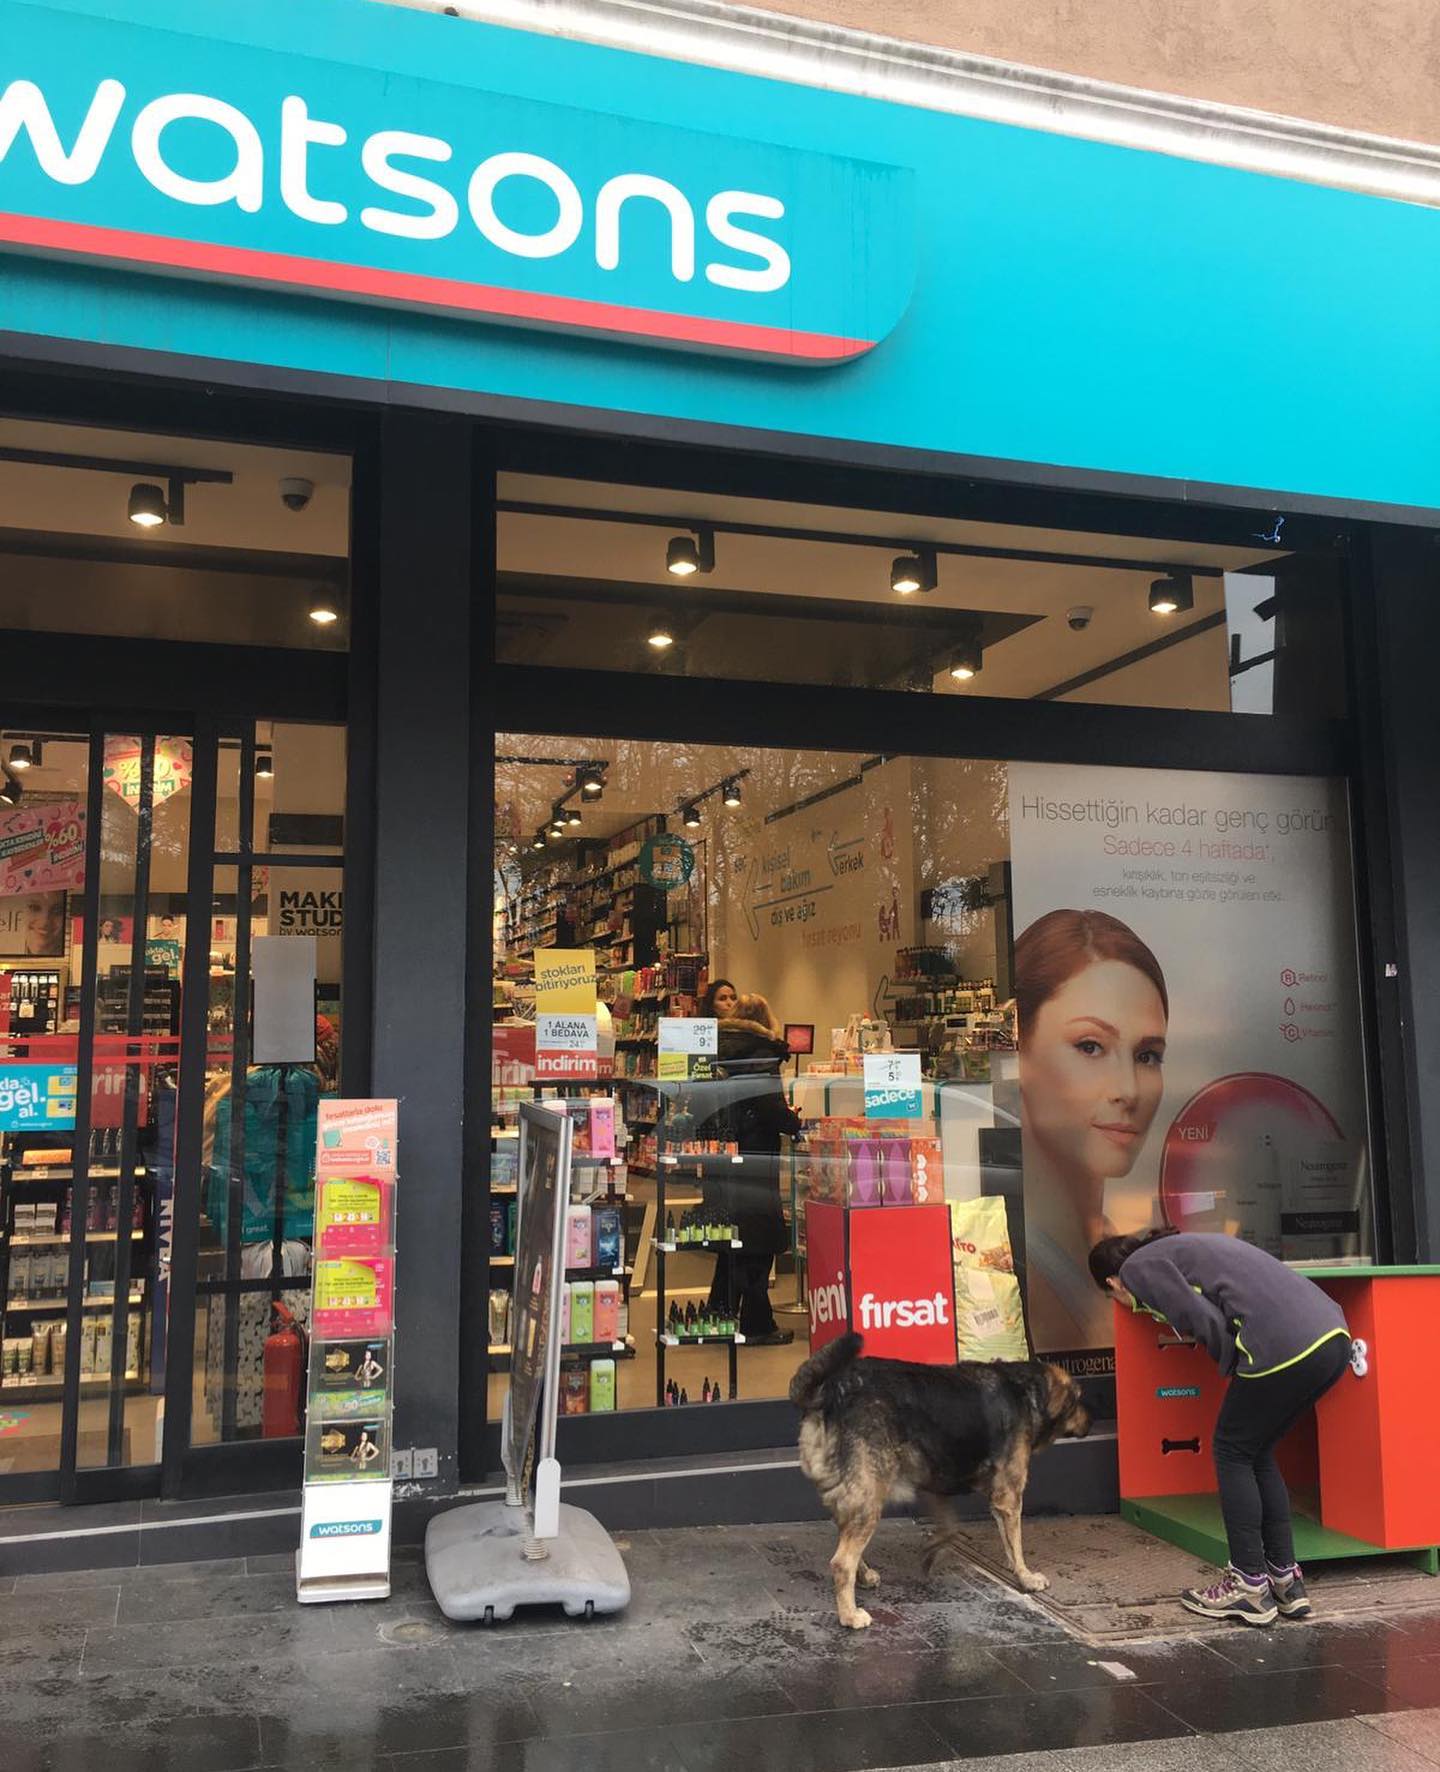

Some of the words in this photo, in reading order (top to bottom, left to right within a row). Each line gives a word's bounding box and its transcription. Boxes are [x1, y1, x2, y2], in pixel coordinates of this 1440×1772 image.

[0, 78, 792, 293] watsons
[1022, 795, 1139, 829] Hissettiğin
[1146, 802, 1206, 826] kadar
[1215, 809, 1268, 834] genç
[1103, 834, 1175, 857] Sadece
[1181, 840, 1192, 857] 4
[555, 1021, 587, 1029] ALANA
[551, 1029, 590, 1038] BEDAVA
[538, 1055, 596, 1071] indirim
[888, 1072, 895, 1081] 5
[865, 1088, 916, 1108] sadece
[19, 1104, 38, 1119] al.
[1178, 1126, 1209, 1141] YENİ
[808, 1271, 848, 1334] yeni
[859, 1291, 949, 1329] fırsat
[1160, 1387, 1196, 1397] watsons
[319, 1522, 373, 1536] watsons
